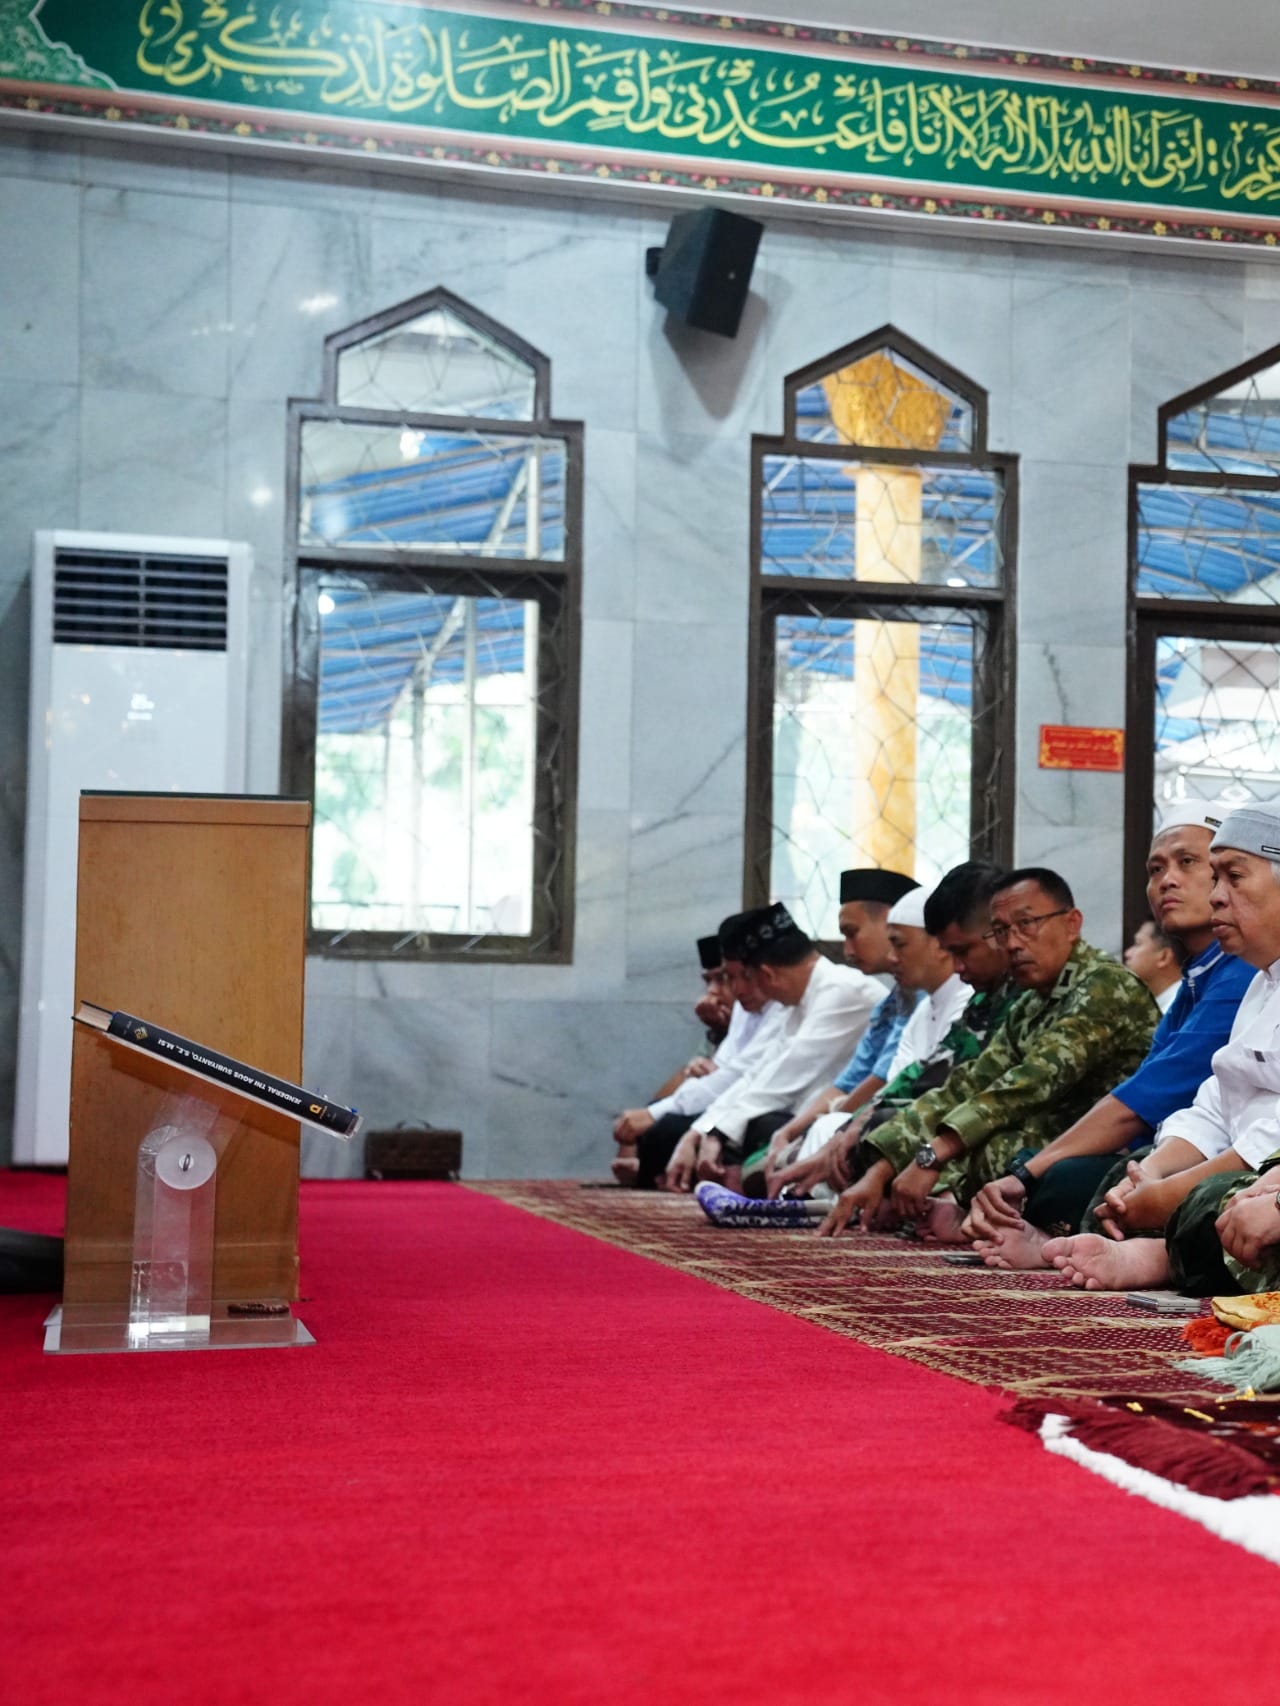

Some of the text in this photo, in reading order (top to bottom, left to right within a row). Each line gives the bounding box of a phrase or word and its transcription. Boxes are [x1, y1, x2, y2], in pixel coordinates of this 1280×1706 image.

[233, 1072, 255, 1085] AGUS
[254, 1080, 267, 1091] TNI
[267, 1086, 302, 1105] JENDERAL
